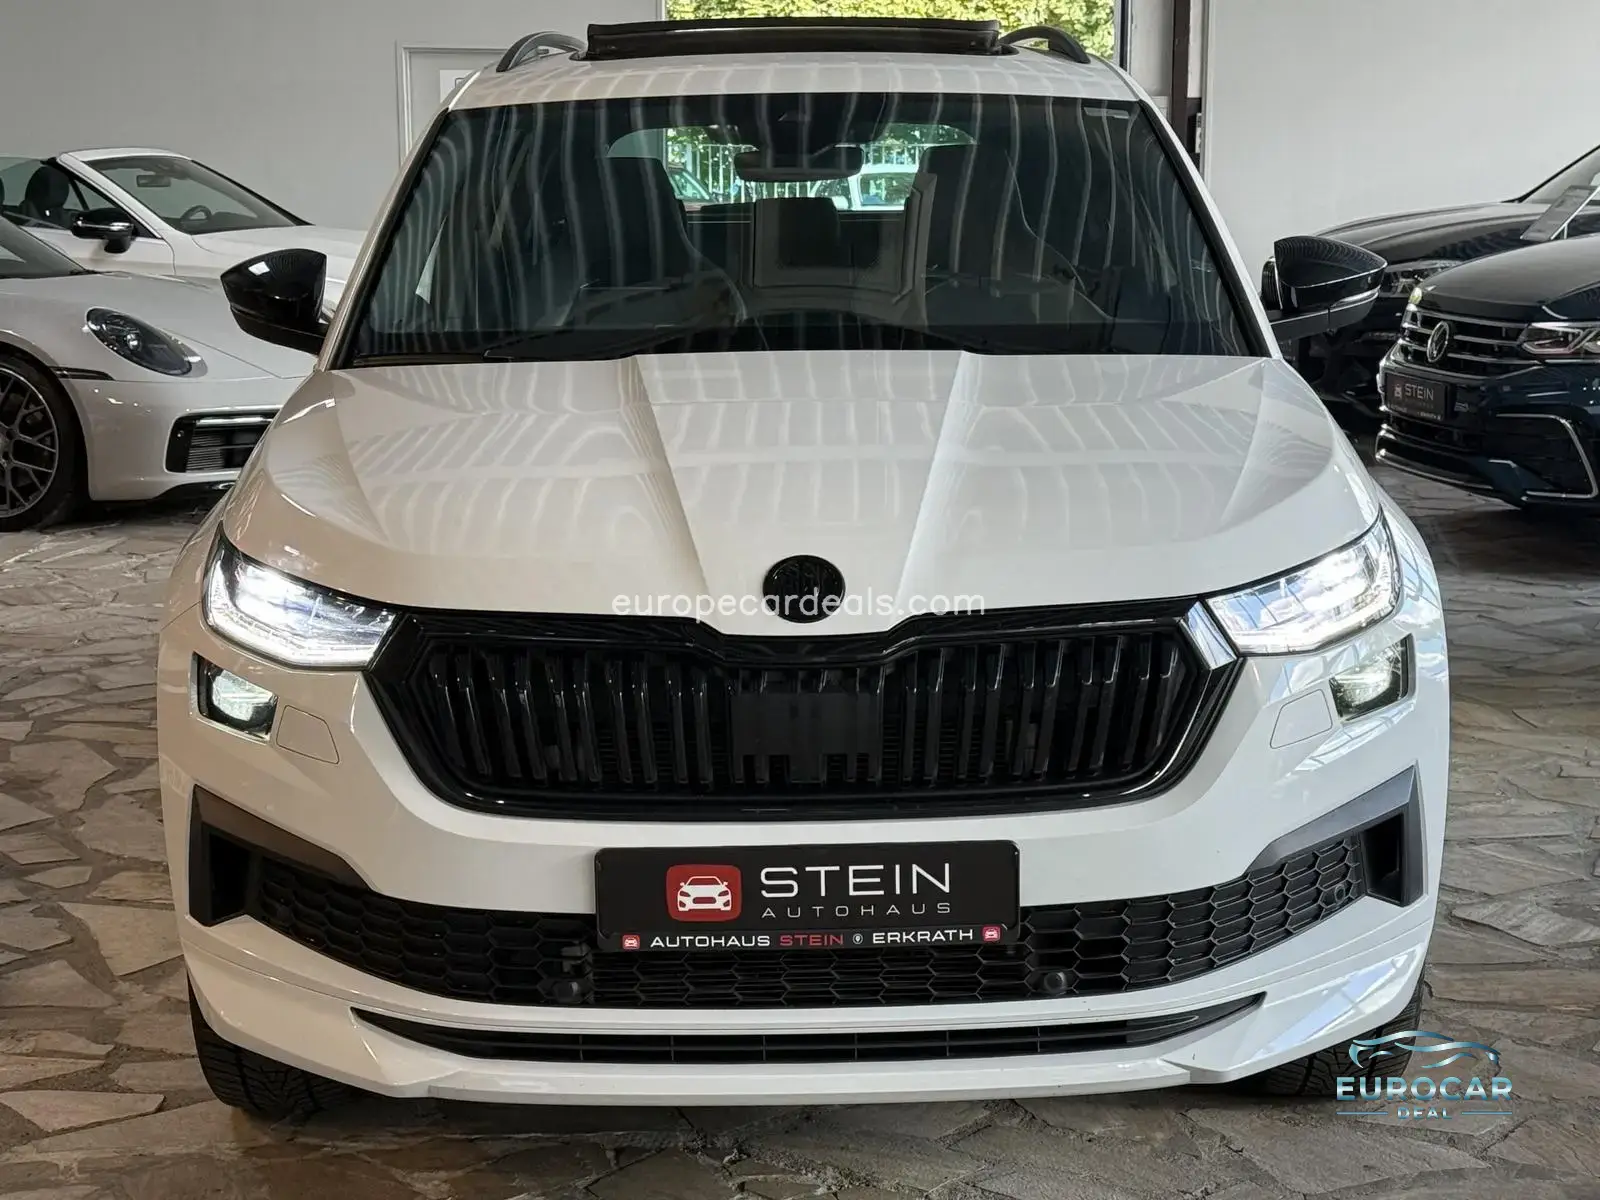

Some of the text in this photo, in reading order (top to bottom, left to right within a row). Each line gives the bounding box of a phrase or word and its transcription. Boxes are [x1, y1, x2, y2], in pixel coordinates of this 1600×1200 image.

[1404, 383, 1434, 401] STEIN
[760, 863, 951, 898] STEIN
[761, 902, 951, 919] AUTOHAUS
[650, 929, 973, 948] AUTOHAUS STEIN ERKRATH
